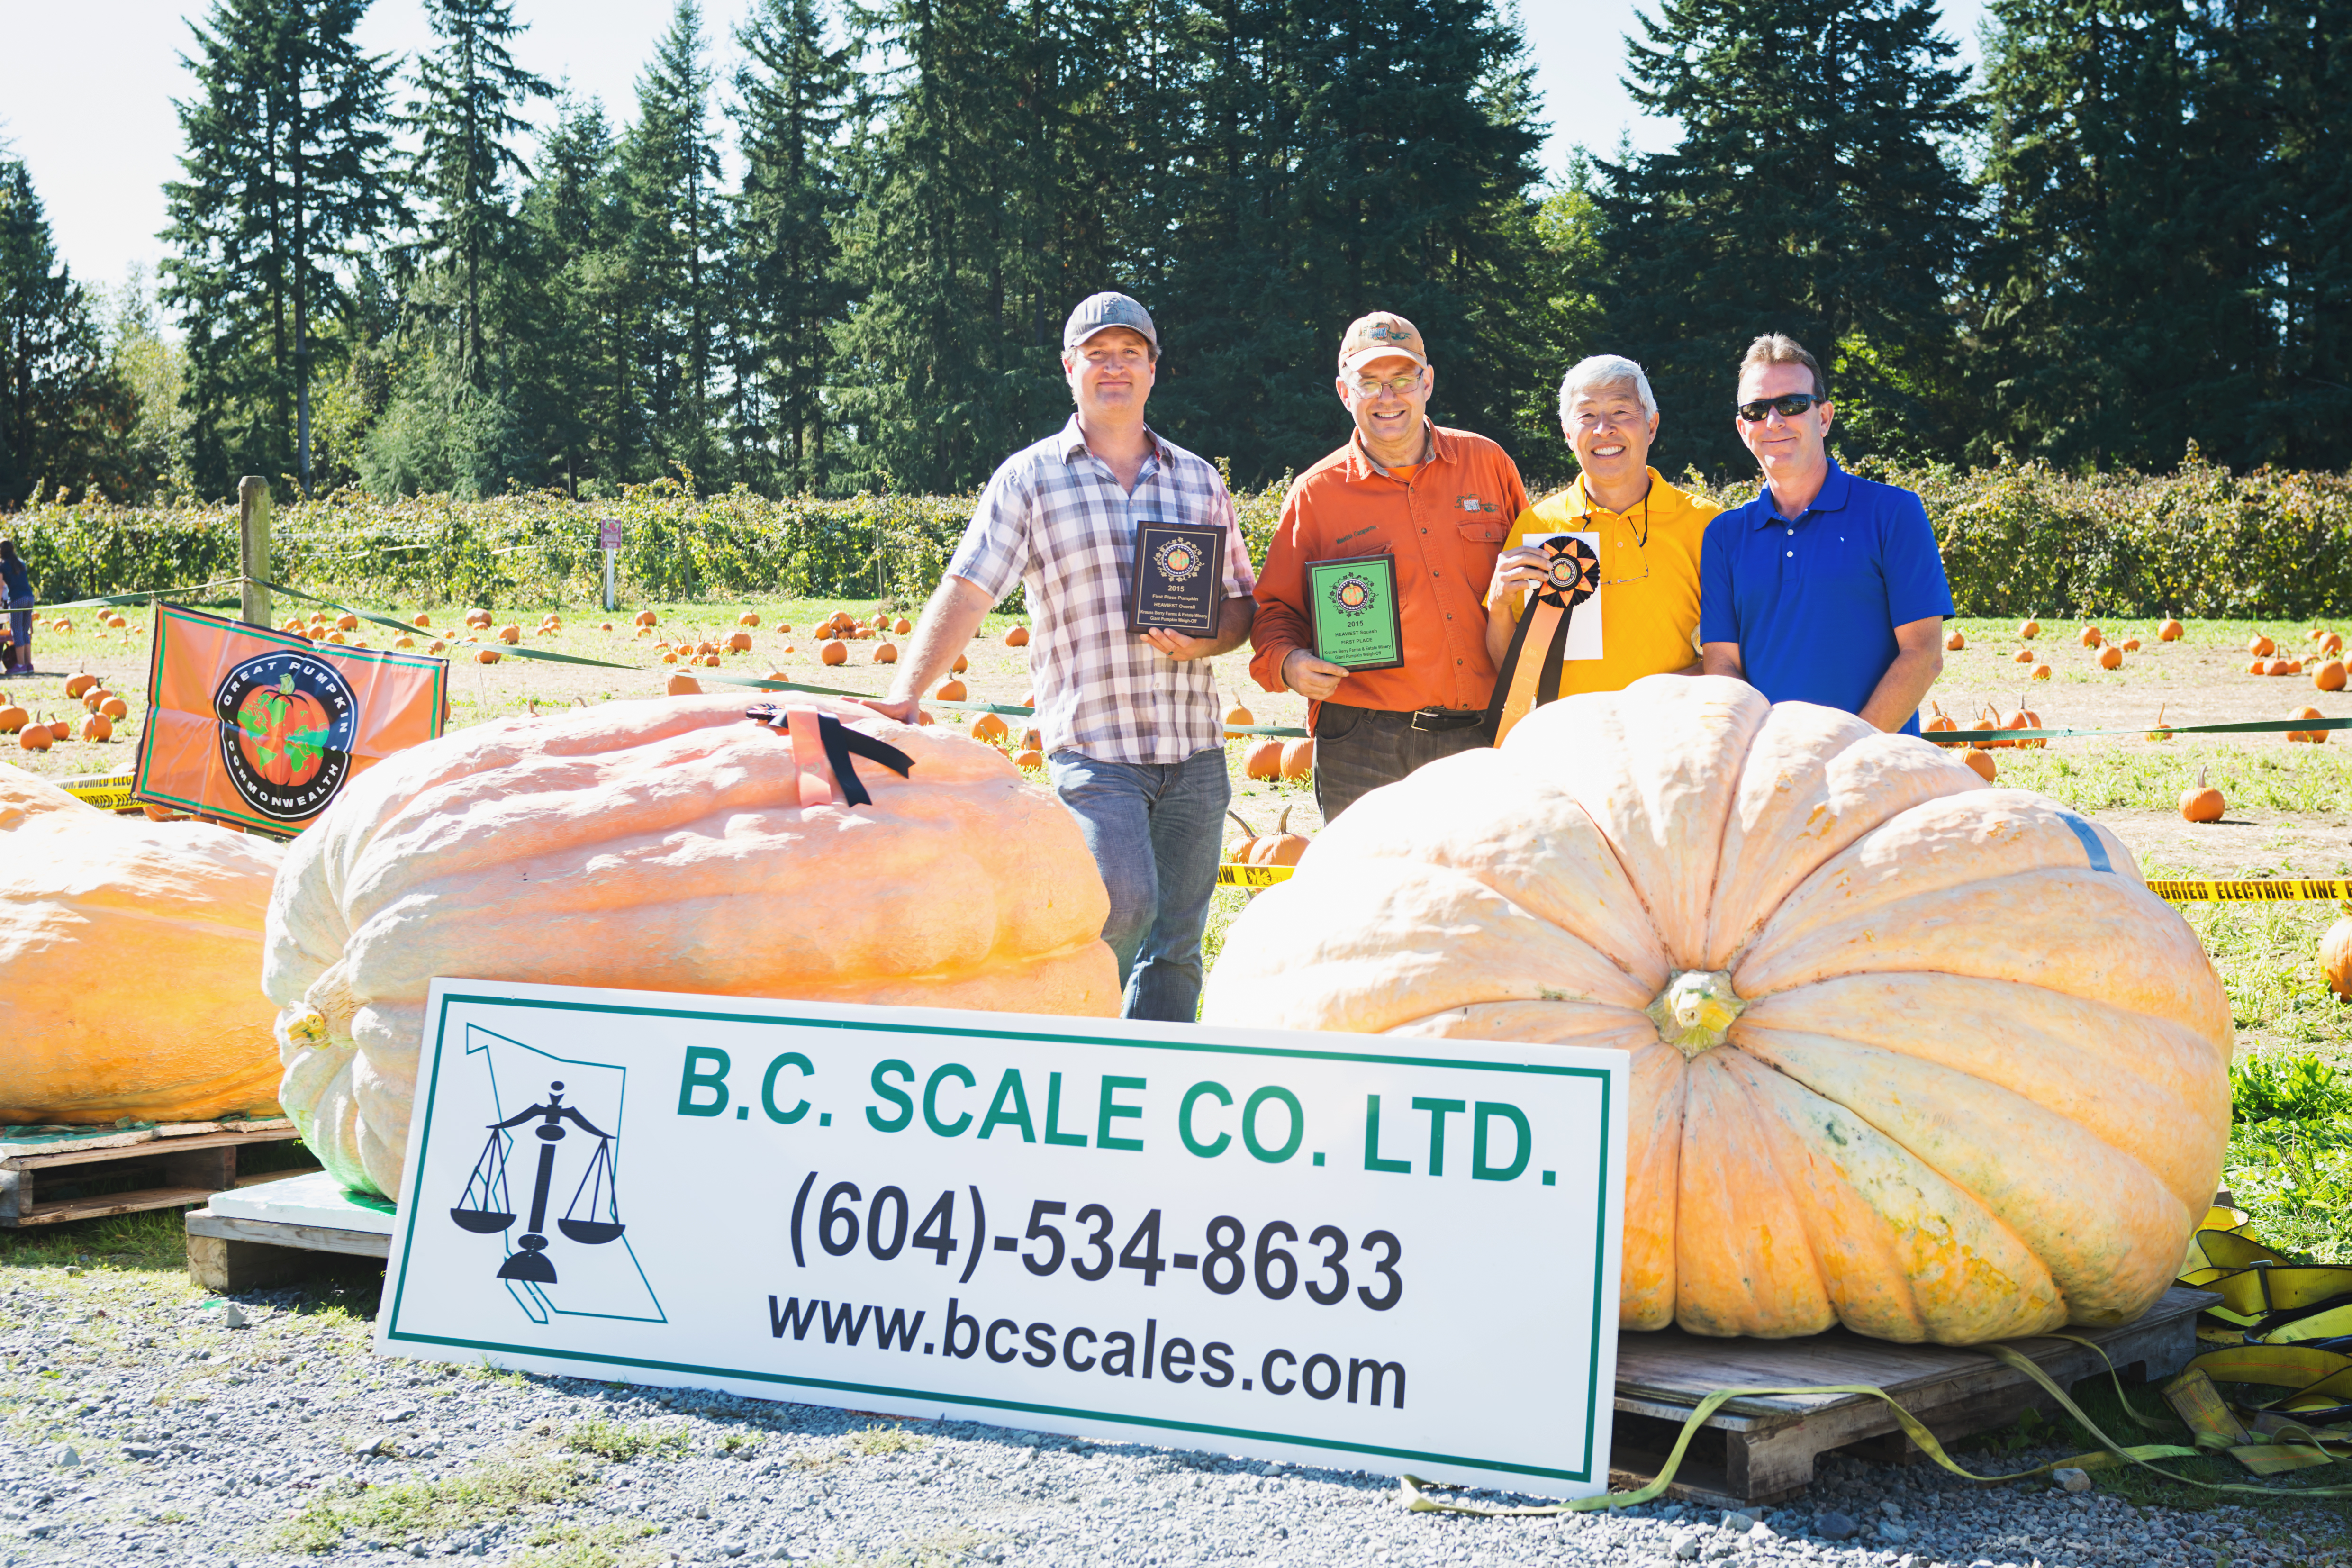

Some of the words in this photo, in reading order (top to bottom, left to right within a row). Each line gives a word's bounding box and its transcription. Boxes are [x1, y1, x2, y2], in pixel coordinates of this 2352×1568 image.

[224, 662, 277, 706] GREAT
[289, 661, 348, 733] PUMPKIN
[228, 740, 339, 807] COMMONWEALTH
[2215, 880, 2294, 899] ELECTRIC
[2301, 880, 2338, 898] LINE
[677, 1046, 832, 1127] B.C.
[866, 1059, 1147, 1151] SCALE
[1179, 1081, 1325, 1167] CO.
[1364, 1095, 1556, 1186] LTD.
[791, 1171, 1402, 1311] (604)-534-8633
[768, 1295, 1406, 1409] www.bcscales.com
